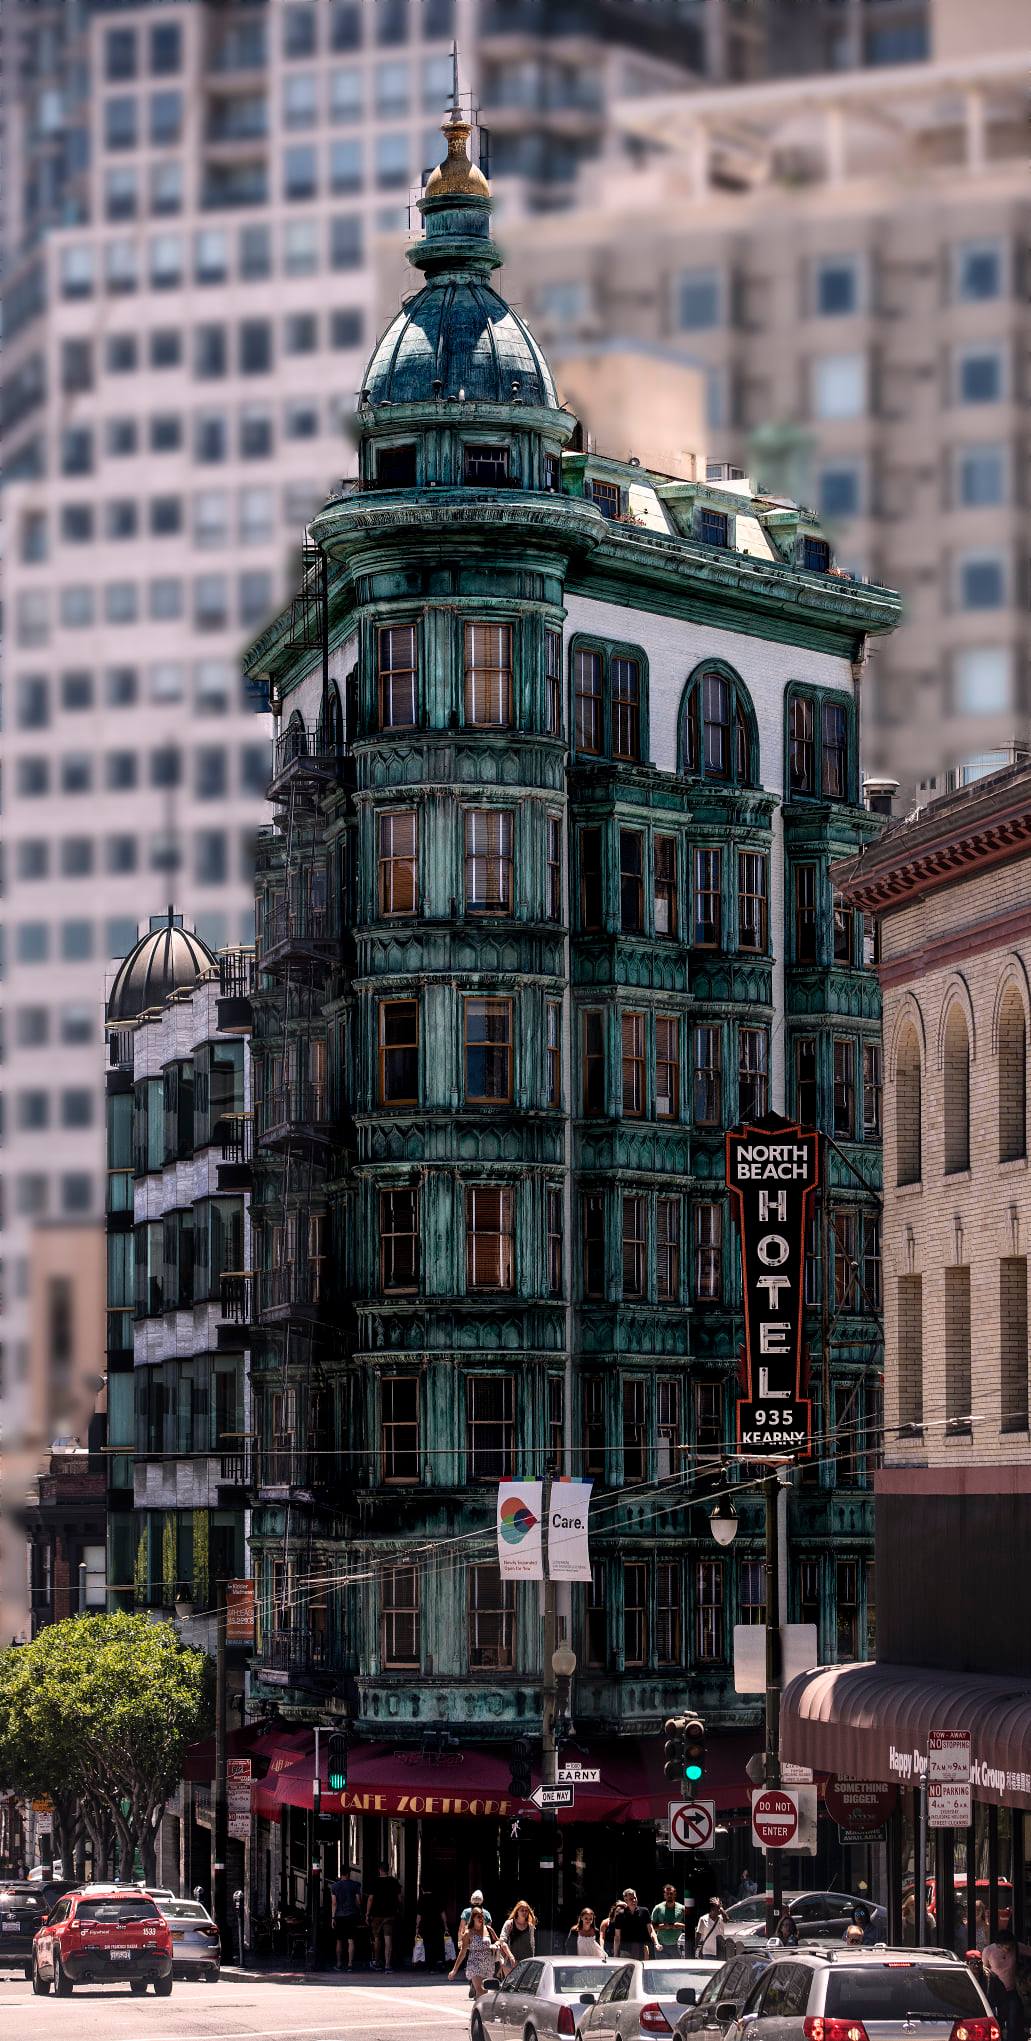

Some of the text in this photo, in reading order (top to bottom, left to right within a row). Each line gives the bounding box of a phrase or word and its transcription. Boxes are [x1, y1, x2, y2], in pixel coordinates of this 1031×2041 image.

[737, 1145, 808, 1161] NORTH
[737, 1163, 808, 1179] BEACH
[756, 1190, 792, 1399] HOTEL
[755, 1410, 793, 1425] 935
[742, 1431, 805, 1445] KEARNY
[552, 1513, 584, 1530] Care.
[929, 1739, 970, 1749] NO STOPPING
[558, 1771, 597, 1780] EARNY
[889, 1746, 912, 1779] Happy
[913, 1749, 928, 1774] Don
[981, 1761, 1006, 1797] Group
[834, 1783, 889, 1793] SOMETHING
[929, 1785, 970, 1797] NO PARKING
[542, 1791, 569, 1801] ONE WAY
[843, 1794, 880, 1804] BIGGER.
[340, 1791, 512, 1816] CAFE ZOETROPE
[759, 1801, 792, 1812] DO NOT
[762, 1826, 788, 1836] ENTER
